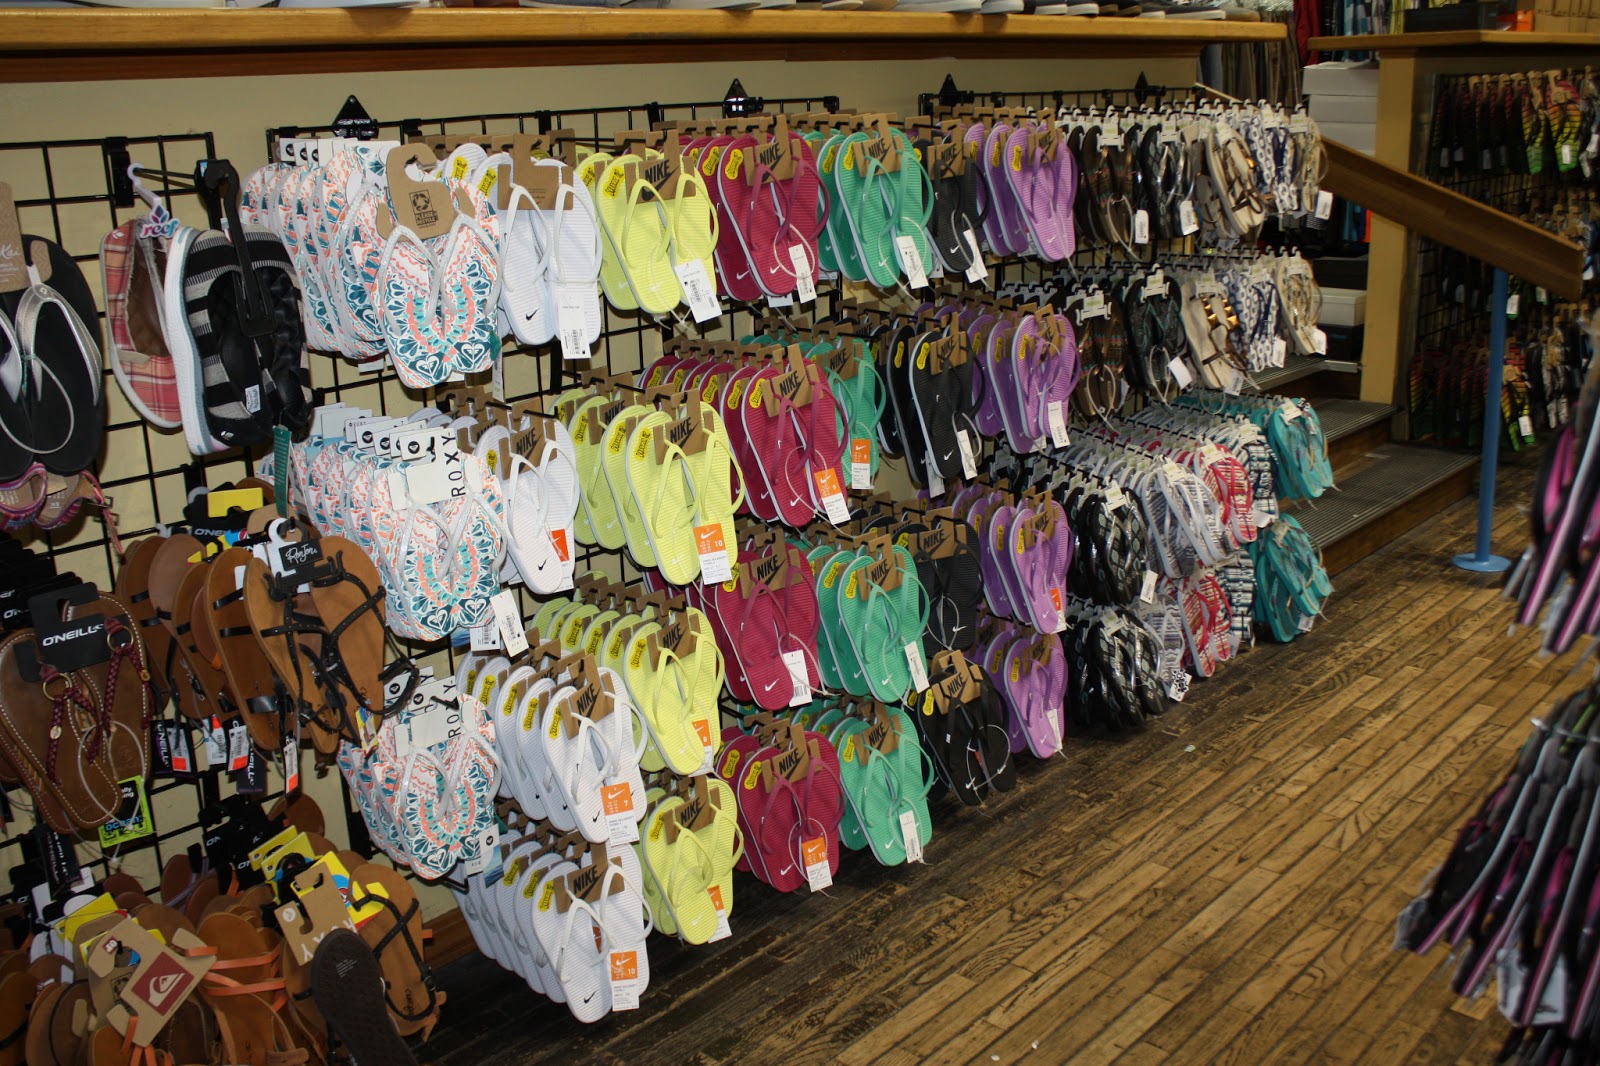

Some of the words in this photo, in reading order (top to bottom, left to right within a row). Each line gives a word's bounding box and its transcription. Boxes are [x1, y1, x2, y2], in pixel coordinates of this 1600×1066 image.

[760, 142, 781, 165] NIKE
[868, 138, 886, 158] NIKE
[645, 159, 670, 182] NIKE
[143, 220, 178, 237] reef
[830, 348, 846, 370] NIKE
[780, 370, 799, 397] NIKE
[516, 427, 536, 455] NIKE
[670, 417, 692, 444] NIKE
[441, 432, 467, 498] ROXY
[714, 539, 723, 547] 10
[924, 528, 945, 549] NIKE
[757, 554, 779, 581] NIKE
[871, 559, 889, 583] NIKE
[42, 624, 99, 647] O'NEILL
[663, 623, 682, 649] NIKE
[577, 682, 597, 712] NIKE
[947, 673, 966, 697] NIKE
[869, 722, 885, 747] NIKE
[779, 748, 801, 775] NIKE
[680, 797, 702, 825] NIKE
[573, 866, 599, 894] NIKE
[627, 967, 636, 975] 10
